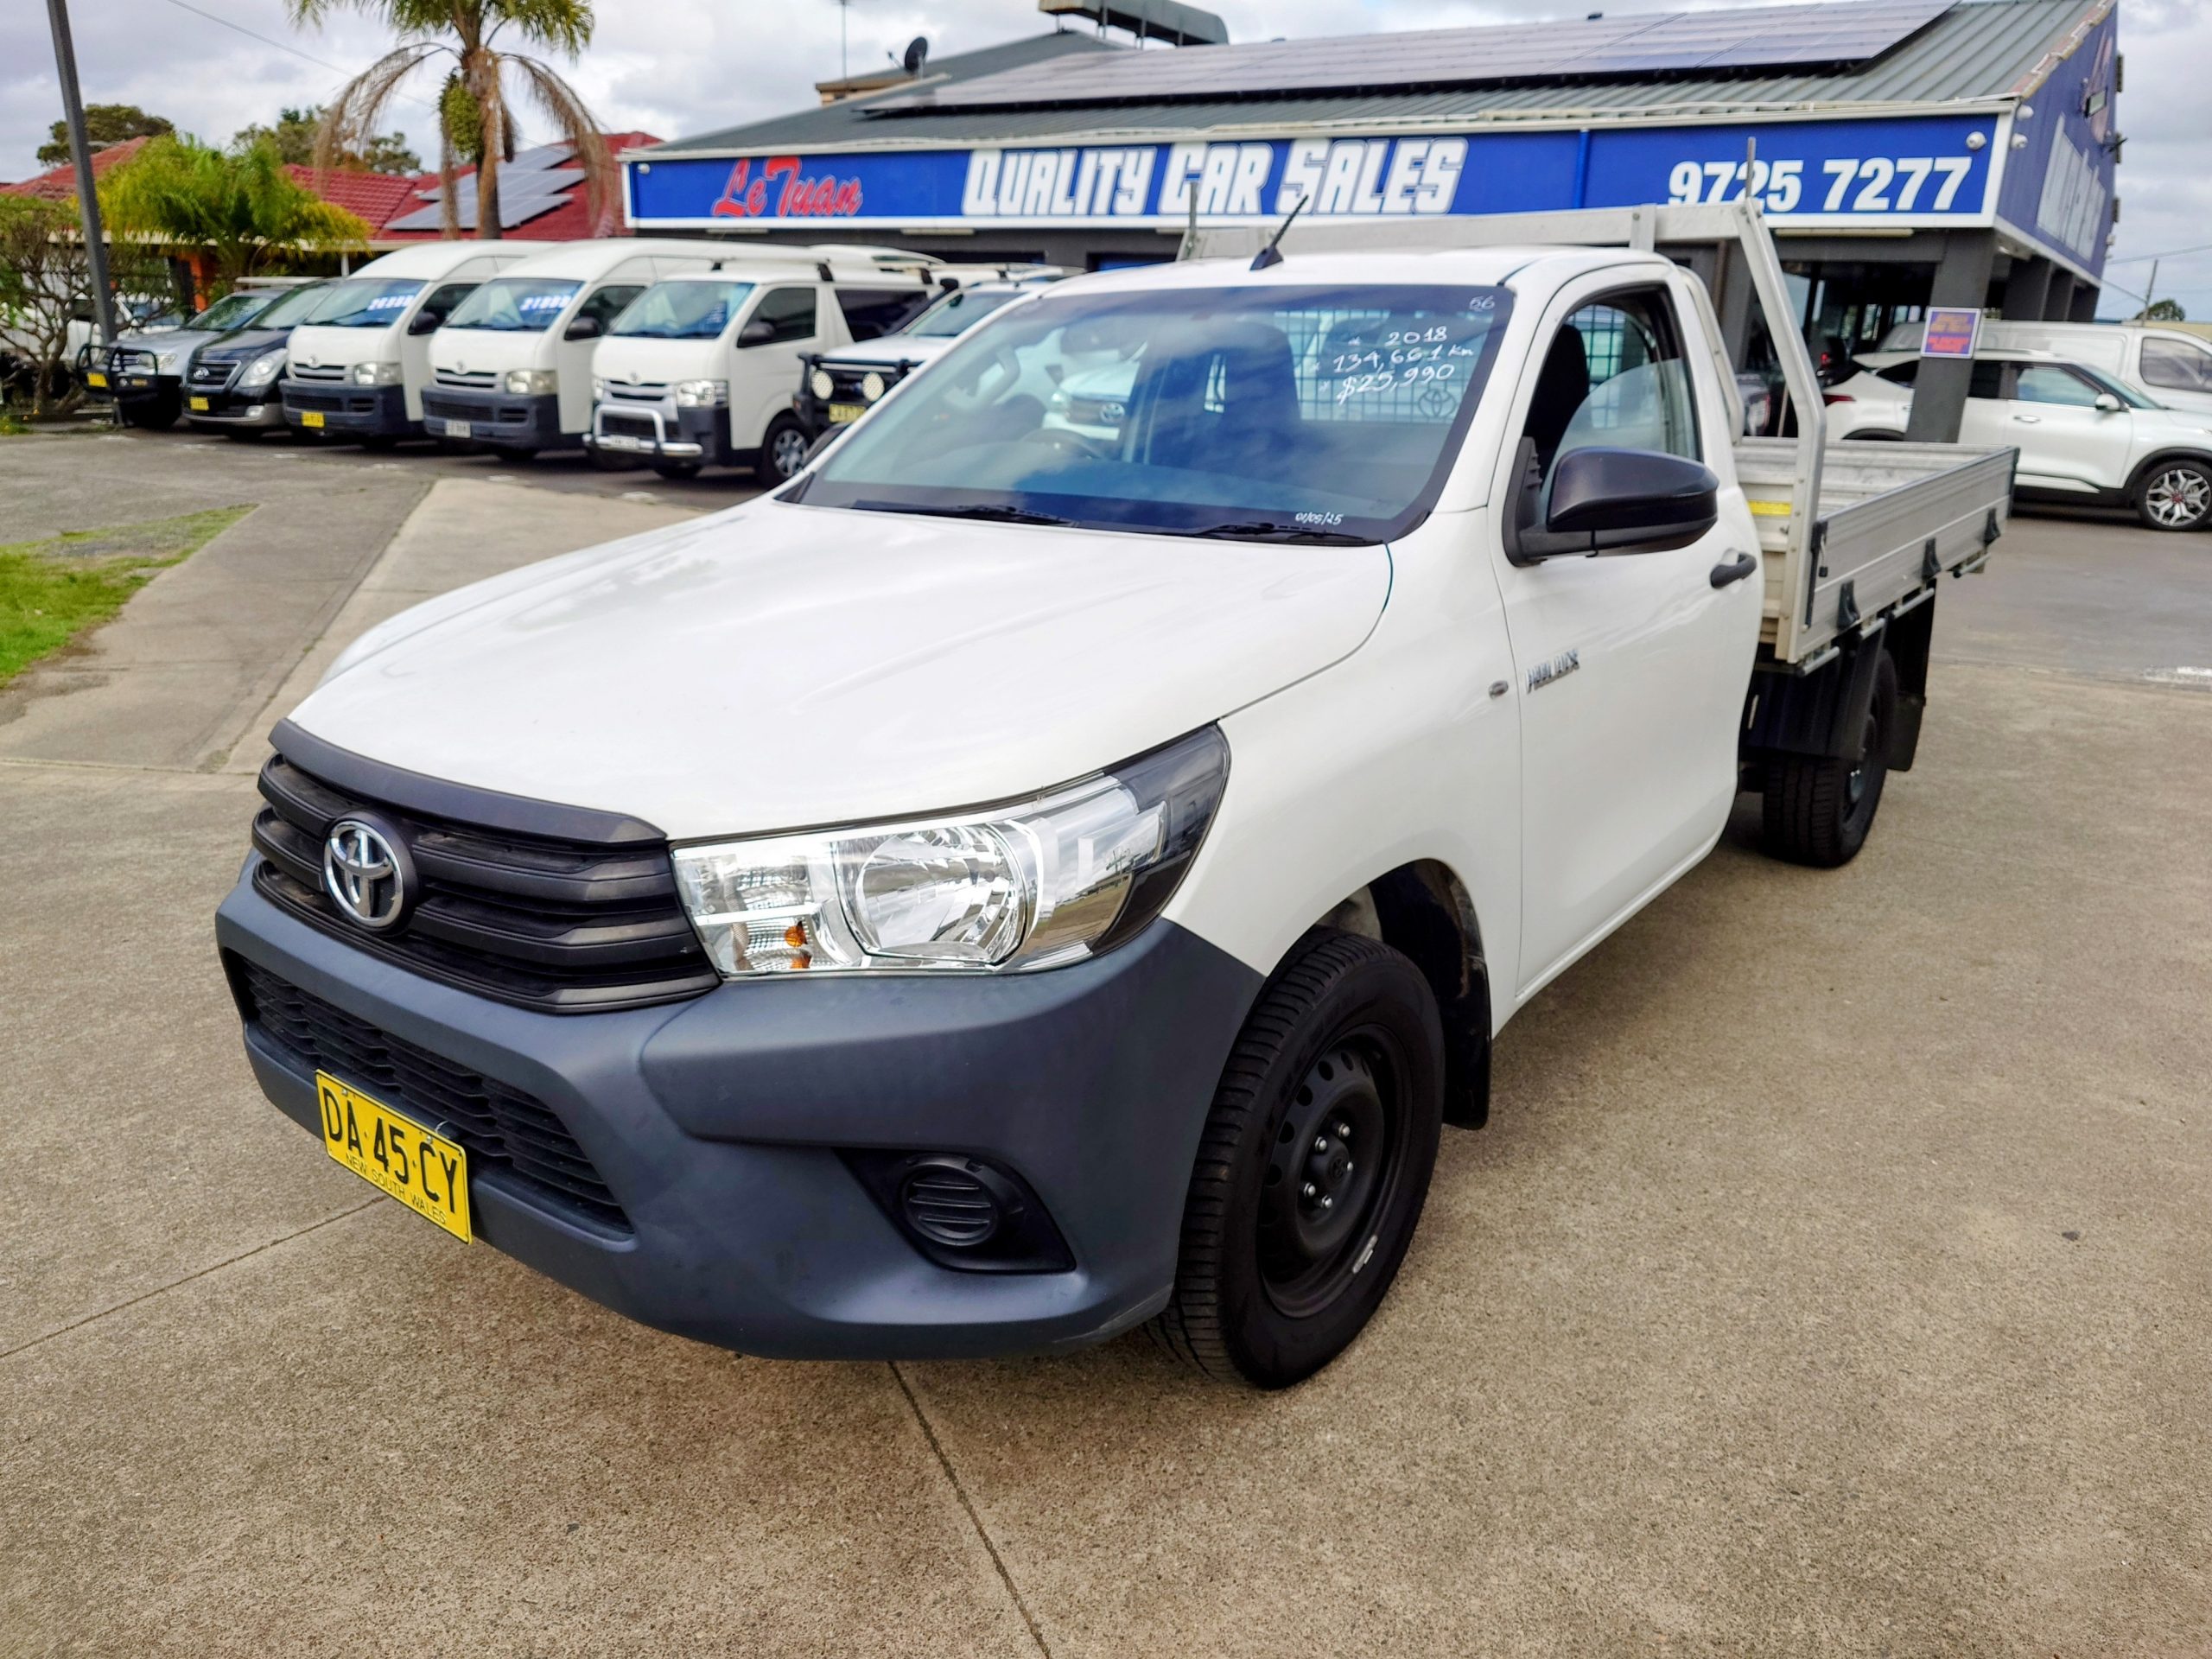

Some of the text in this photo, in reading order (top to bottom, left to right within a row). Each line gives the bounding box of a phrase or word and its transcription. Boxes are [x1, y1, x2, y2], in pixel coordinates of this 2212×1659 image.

[712, 155, 863, 218] Le Tuan
[962, 137, 1469, 216] QUALITY CAR SALES
[1668, 156, 1973, 213] 9725 7277
[1384, 325, 1448, 347] 2018
[1336, 363, 1455, 405] $25,990
[346, 1153, 447, 1225] NEW SOUTH WALES
